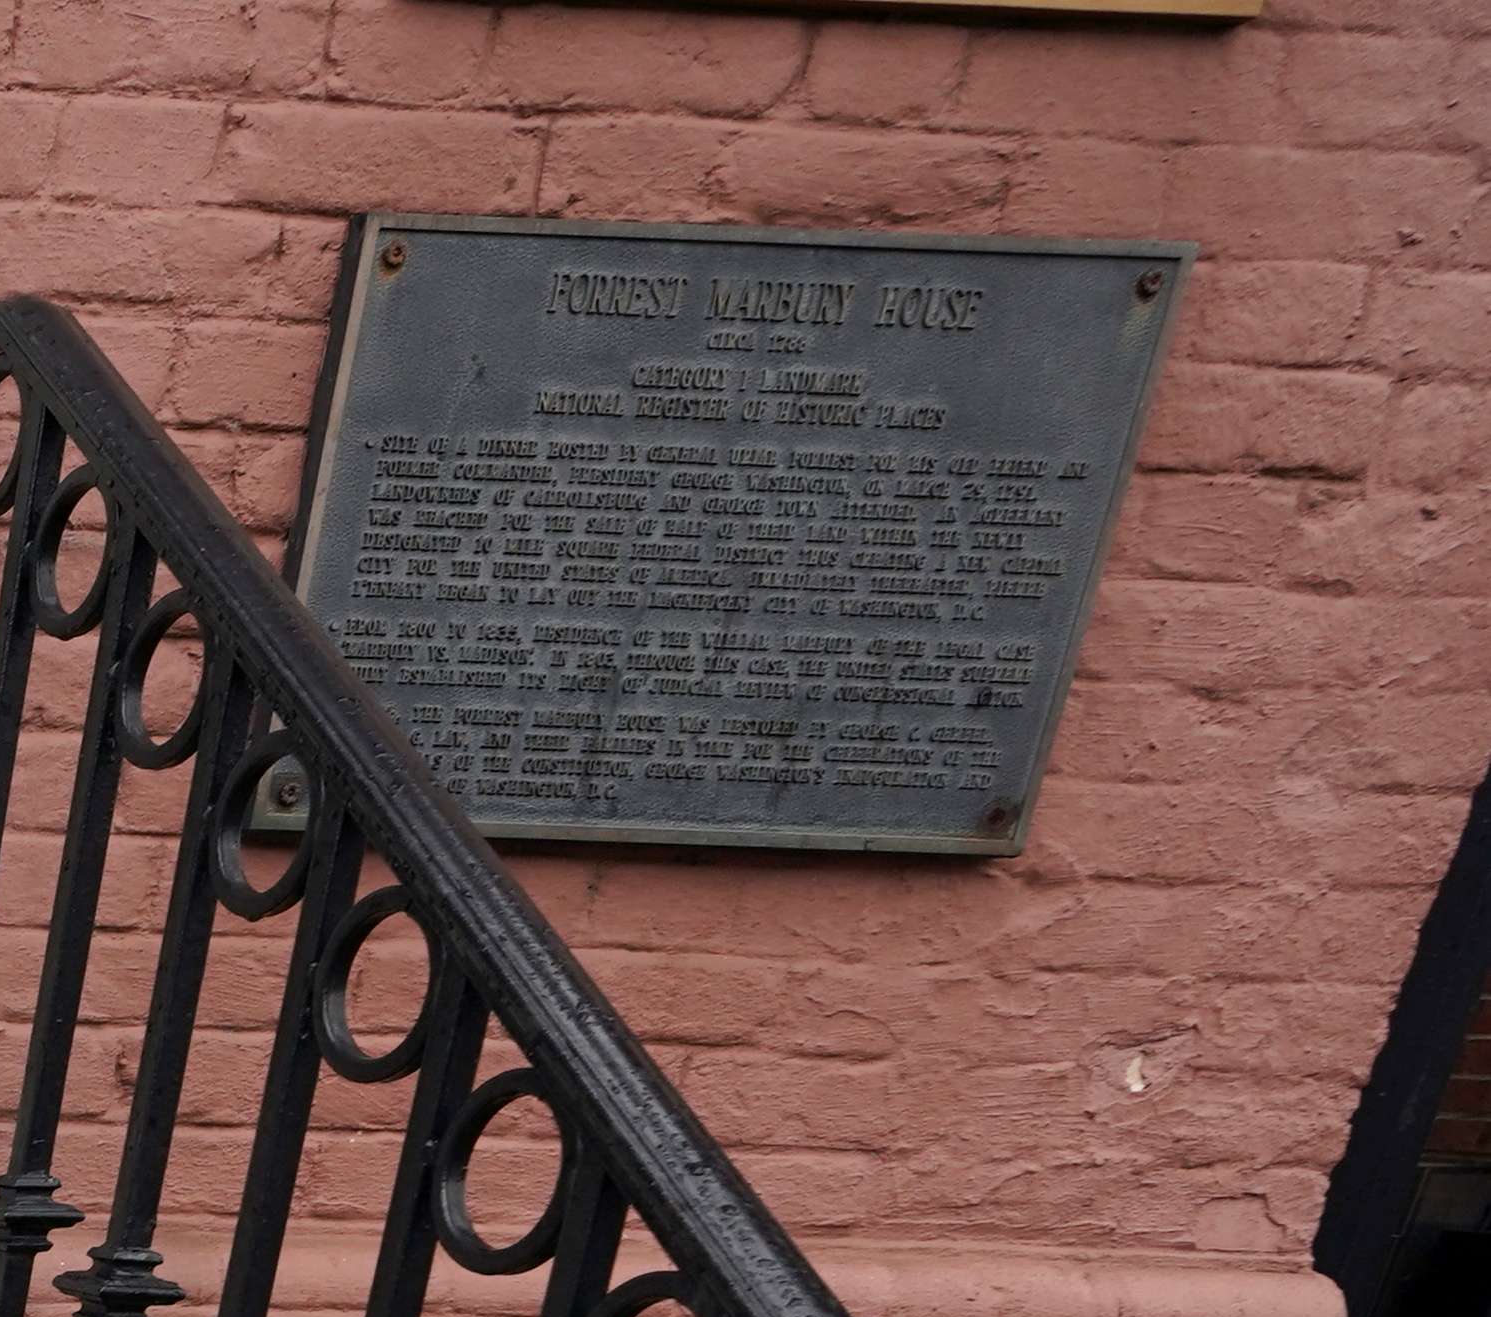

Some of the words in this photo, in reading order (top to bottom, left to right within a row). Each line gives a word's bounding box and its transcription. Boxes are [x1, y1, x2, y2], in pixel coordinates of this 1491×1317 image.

[547, 273, 687, 318] FORREST
[705, 279, 856, 325] MARBURY
[873, 286, 985, 330] HOUSE
[706, 332, 756, 352] CIRCA
[631, 365, 731, 391] CATEGORY
[758, 370, 865, 397] LANDMARK
[534, 390, 625, 417] NATIONAL
[634, 396, 729, 421] REGISTER
[741, 400, 767, 421] OF
[771, 402, 868, 427] HISTORIC
[873, 406, 947, 430] PLACES
[380, 435, 419, 456] SITE
[428, 437, 448, 456] OF
[476, 439, 540, 459] DINNER
[545, 441, 609, 462] HOSTED
[616, 443, 641, 463] BY
[647, 445, 719, 467] GENERAL
[786, 452, 858, 471] FORREST
[865, 455, 901, 473] FOR
[906, 456, 940, 475] HIS
[947, 457, 982, 476] OLD
[986, 459, 1049, 479] FRIEND
[374, 460, 441, 479] FORMER
[453, 462, 559, 487] COMMANDER,
[567, 467, 661, 488] PRESIDENT
[671, 471, 735, 491] GEORGE
[746, 474, 850, 500] WASHINGTON,
[863, 479, 885, 498] ON
[892, 480, 951, 500] MARCH
[370, 483, 482, 506] LANDOWNERS
[492, 488, 516, 507] OF
[657, 494, 692, 514] AND
[702, 497, 767, 517] GEORGE
[774, 500, 819, 520] TOWN
[968, 507, 1067, 528] AGREEMENT
[367, 507, 404, 527] WAS
[412, 510, 489, 530] REACHED
[500, 513, 533, 532] FOR
[544, 514, 578, 533] THE
[584, 516, 628, 536] SALE
[635, 519, 659, 537] OF
[662, 519, 709, 539] HALF
[717, 521, 740, 540] OF
[746, 522, 796, 542] THEIR
[805, 525, 849, 545] LAND
[860, 527, 919, 547] WITHIN
[928, 529, 962, 549] THE
[970, 531, 1028, 552] NEWLY
[360, 532, 463, 553] DESIGNATED
[501, 537, 546, 556] MILE
[554, 539, 621, 560] SQUARE
[628, 543, 701, 563] FEDERAL
[712, 546, 789, 566] DISTRICT
[797, 549, 841, 568] THUS
[847, 551, 927, 571] CREATING
[954, 555, 991, 574] NEW
[357, 556, 399, 576] CITY
[405, 558, 438, 577] FOR
[449, 559, 483, 579] THE
[491, 561, 551, 580] UNITED
[561, 564, 620, 584] STATES
[628, 567, 651, 585] OF
[746, 571, 859, 592] IMMEDIATELY
[435, 583, 491, 602] BEGAN
[498, 585, 520, 604] TO
[527, 587, 561, 606] LAY
[566, 588, 599, 607] OUT
[605, 590, 639, 609] THE
[646, 592, 755, 613] MAGNIFICENT
[763, 597, 800, 615] CITY
[809, 598, 833, 616] OF
[838, 599, 943, 623] WASHINGTON,
[343, 618, 389, 639] FROM
[446, 622, 468, 640] TO
[532, 625, 623, 646] RESIDENCE
[632, 630, 656, 648] OF
[659, 630, 692, 649] THE
[701, 632, 772, 652] WILLIAM
[779, 634, 857, 655] MARBURY
[866, 638, 890, 656] OF
[893, 639, 929, 658] THE
[934, 640, 987, 660] LEGAL
[995, 643, 1036, 662] CASE
[396, 668, 507, 688] ESTABLISHED
[517, 672, 547, 690] ITS
[557, 674, 611, 692] RIGHT
[622, 677, 648, 695] OF
[649, 678, 726, 697] JUDICIAL
[733, 681, 797, 700] REVIEW
[807, 684, 828, 701] OF
[833, 685, 956, 706] CONGRESSIONAL
[549, 649, 568, 668] IN
[626, 653, 696, 672] THROUGH
[703, 656, 742, 675] THIS
[795, 660, 830, 678] THE
[834, 661, 893, 680] UNITED
[898, 664, 955, 682] STATES
[959, 666, 1035, 686] SUPREME
[411, 706, 445, 724] THE
[451, 708, 523, 727] FORREST
[530, 711, 606, 730] MARBURY
[614, 714, 667, 733] HOUSE
[678, 717, 711, 735] WAS
[718, 719, 799, 739] RESTORED
[838, 724, 901, 742] GEORGE
[479, 733, 511, 751] AND
[523, 735, 572, 753] THEIR
[580, 737, 656, 756] FAMILIES
[665, 740, 685, 758] IN
[694, 741, 735, 759] TIME
[741, 743, 774, 761] FOR
[781, 745, 815, 763] THE
[823, 746, 934, 767] CELEBRATIONS
[943, 751, 965, 768] OF
[969, 752, 1003, 770] THE
[447, 779, 469, 795] OF
[454, 755, 476, 773] OF
[482, 756, 512, 774] THE
[645, 763, 708, 781] GEORGE
[831, 770, 950, 791] INAUGURATION
[957, 774, 994, 792] AND
